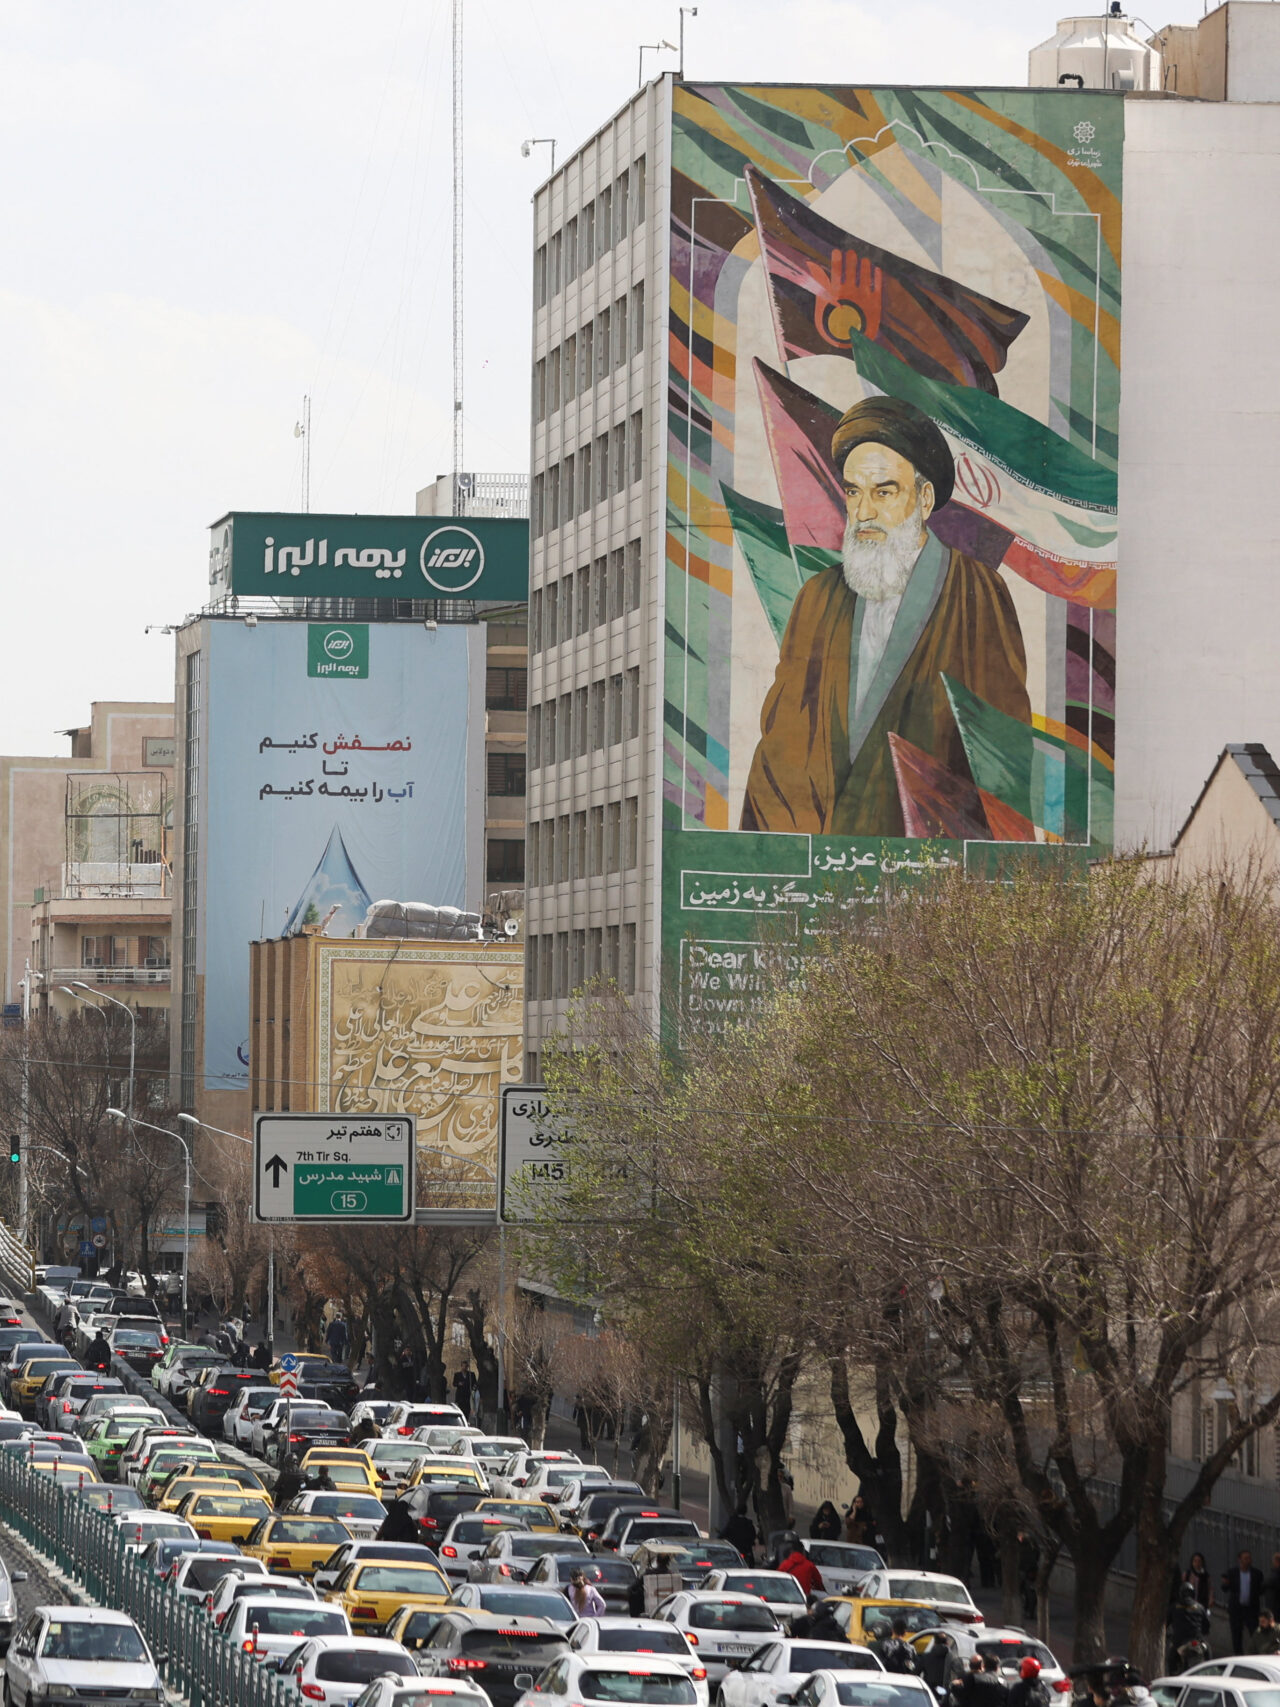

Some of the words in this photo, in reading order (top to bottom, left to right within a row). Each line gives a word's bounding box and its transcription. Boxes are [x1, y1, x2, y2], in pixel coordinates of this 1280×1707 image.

[264, 536, 328, 576] البرز
[334, 547, 407, 578] بیمه
[317, 662, 337, 674] البرز
[338, 665, 359, 675] بیمه
[259, 732, 318, 754] کنیم
[322, 733, 412, 755] نصفش
[322, 760, 349, 775] تا
[259, 779, 315, 800] کنیم
[318, 782, 368, 803] بیمه
[372, 782, 384, 803] را
[387, 781, 415, 803] آب
[690, 881, 740, 905] زمین
[742, 886, 766, 907] به
[689, 946, 747, 969] Dear
[689, 971, 720, 990] We
[326, 1126, 348, 1140] تیر
[348, 1126, 382, 1143] هفتم
[296, 1151, 314, 1161] 7th
[316, 1151, 330, 1161] Tir
[333, 1151, 351, 1163] Sq.
[299, 1172, 345, 1185] مدرس
[347, 1168, 382, 1183] شهید
[340, 1194, 357, 1208] 15
